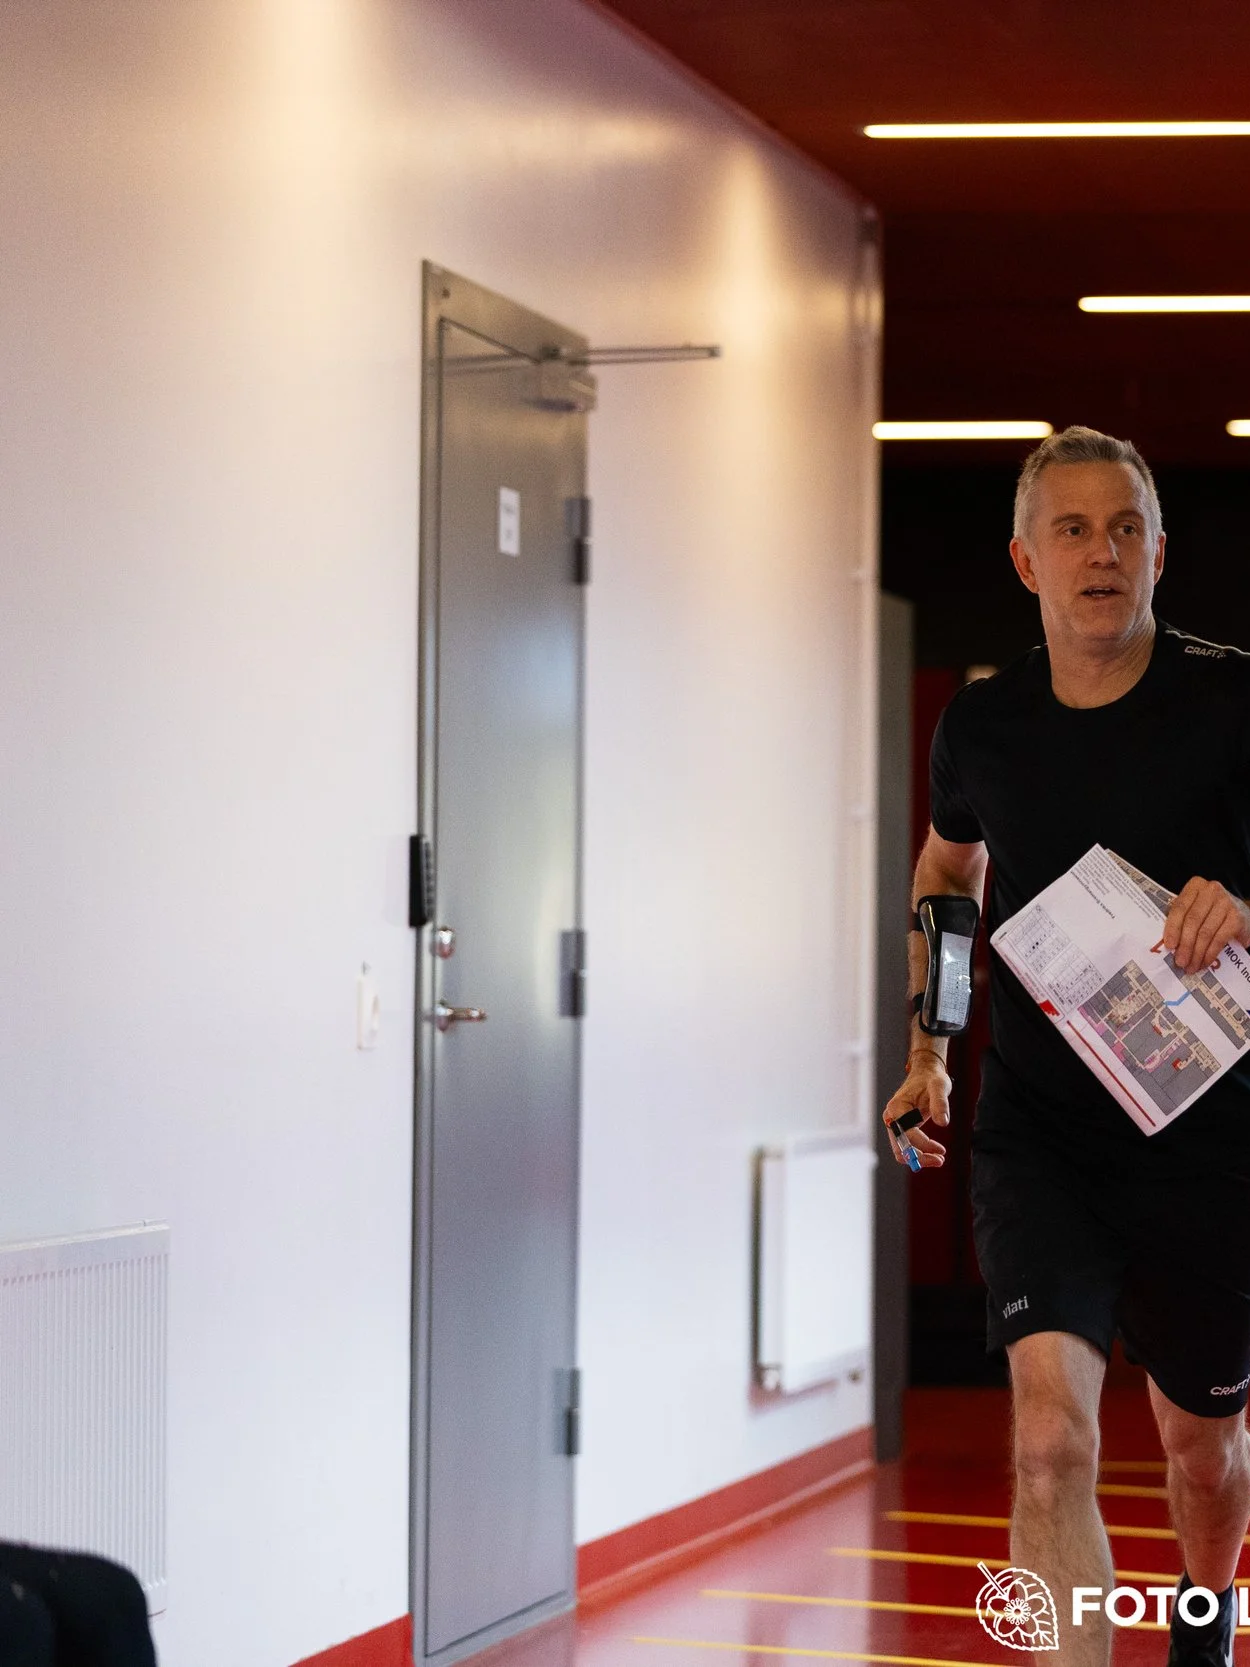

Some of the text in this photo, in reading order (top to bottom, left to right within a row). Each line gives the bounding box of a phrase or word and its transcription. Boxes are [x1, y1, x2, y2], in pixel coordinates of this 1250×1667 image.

[1184, 645, 1219, 658] CRAFT
[1002, 1295, 1029, 1319] viati
[1210, 1379, 1248, 1395] CRAFT
